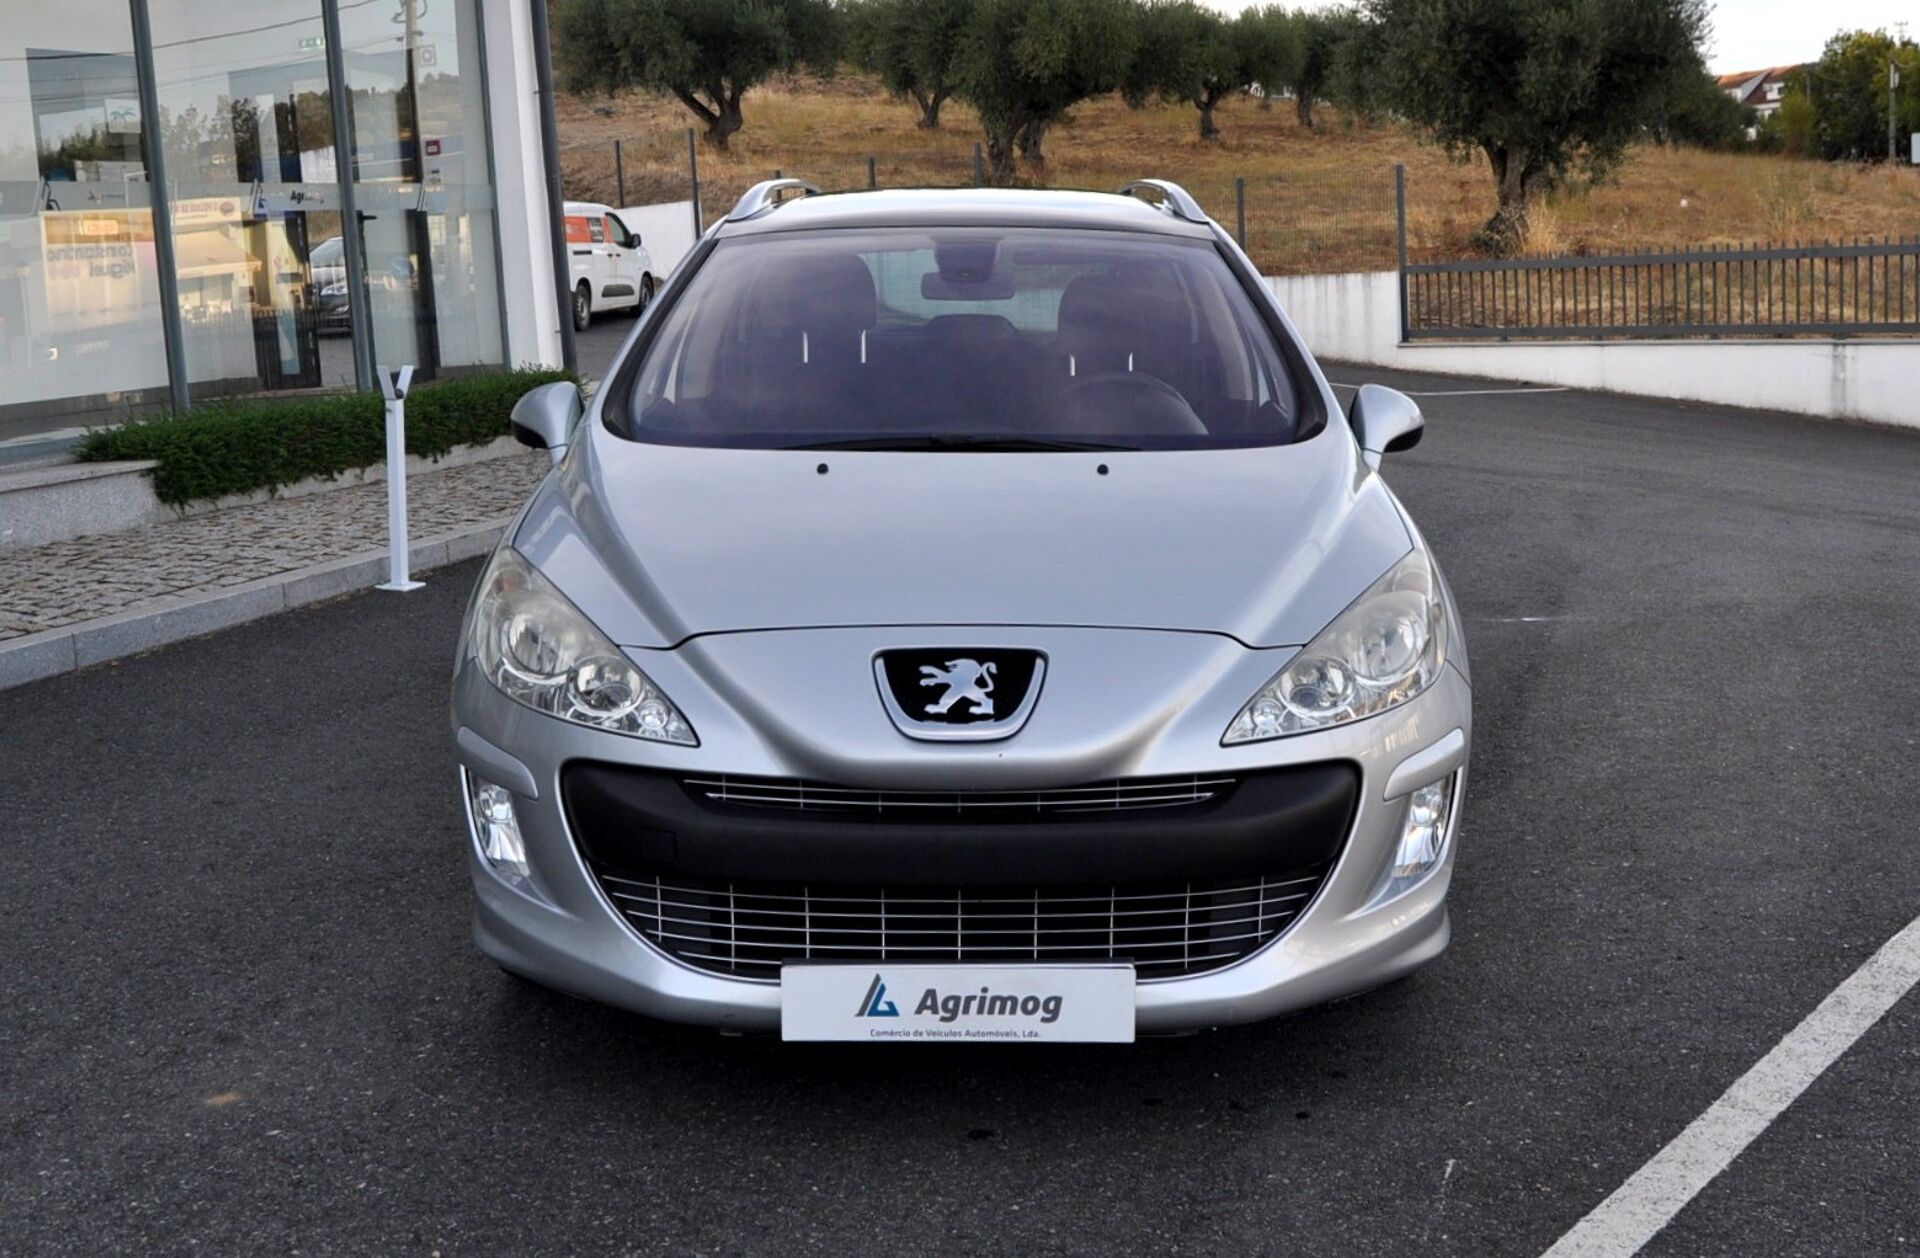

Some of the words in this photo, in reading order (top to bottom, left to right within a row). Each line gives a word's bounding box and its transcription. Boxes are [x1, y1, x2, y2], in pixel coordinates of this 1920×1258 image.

[914, 986, 1063, 1023] Agrimog
[870, 1028, 911, 1038] Comércio
[913, 1028, 923, 1038] de
[1022, 1029, 1041, 1039] Lda.
